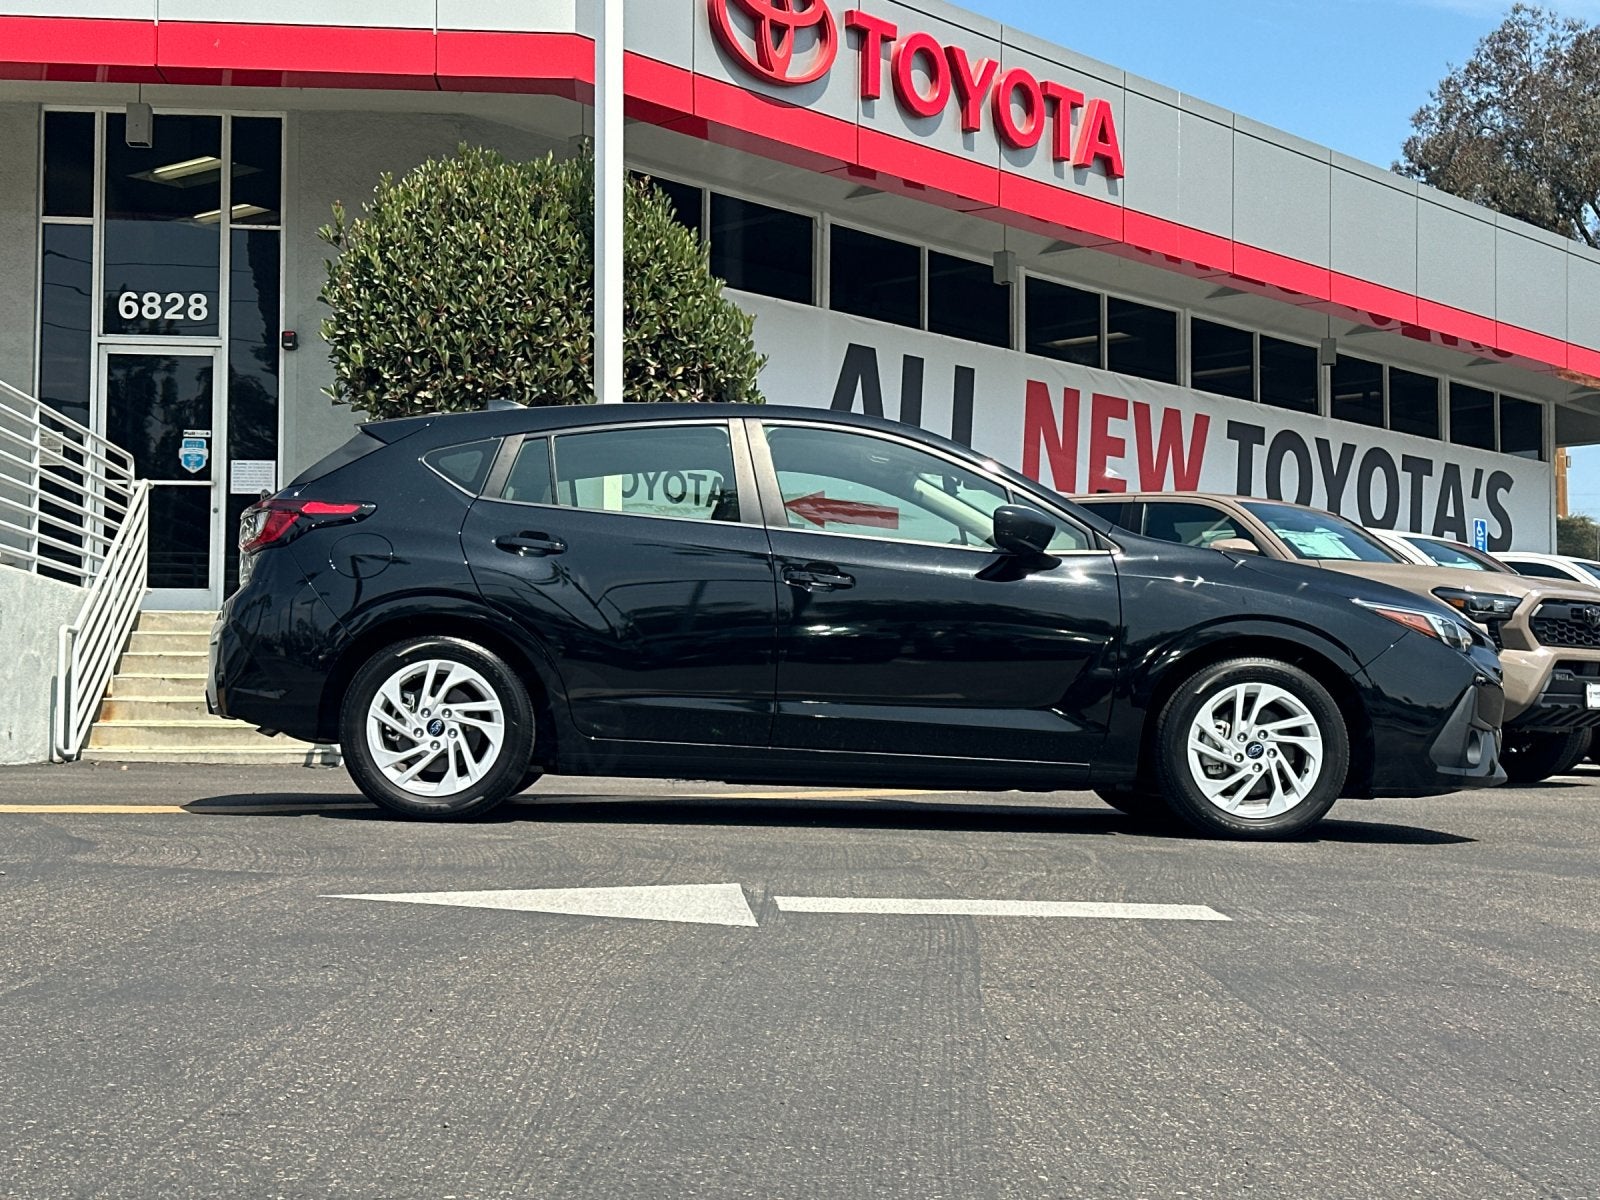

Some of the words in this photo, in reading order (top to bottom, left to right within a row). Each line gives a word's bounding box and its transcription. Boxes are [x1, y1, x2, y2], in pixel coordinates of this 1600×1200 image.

[845, 9, 1124, 179] TOYOTA
[118, 291, 208, 321] 6828
[1022, 379, 1211, 494] NEW
[1227, 419, 1514, 553] TOYOTA'S
